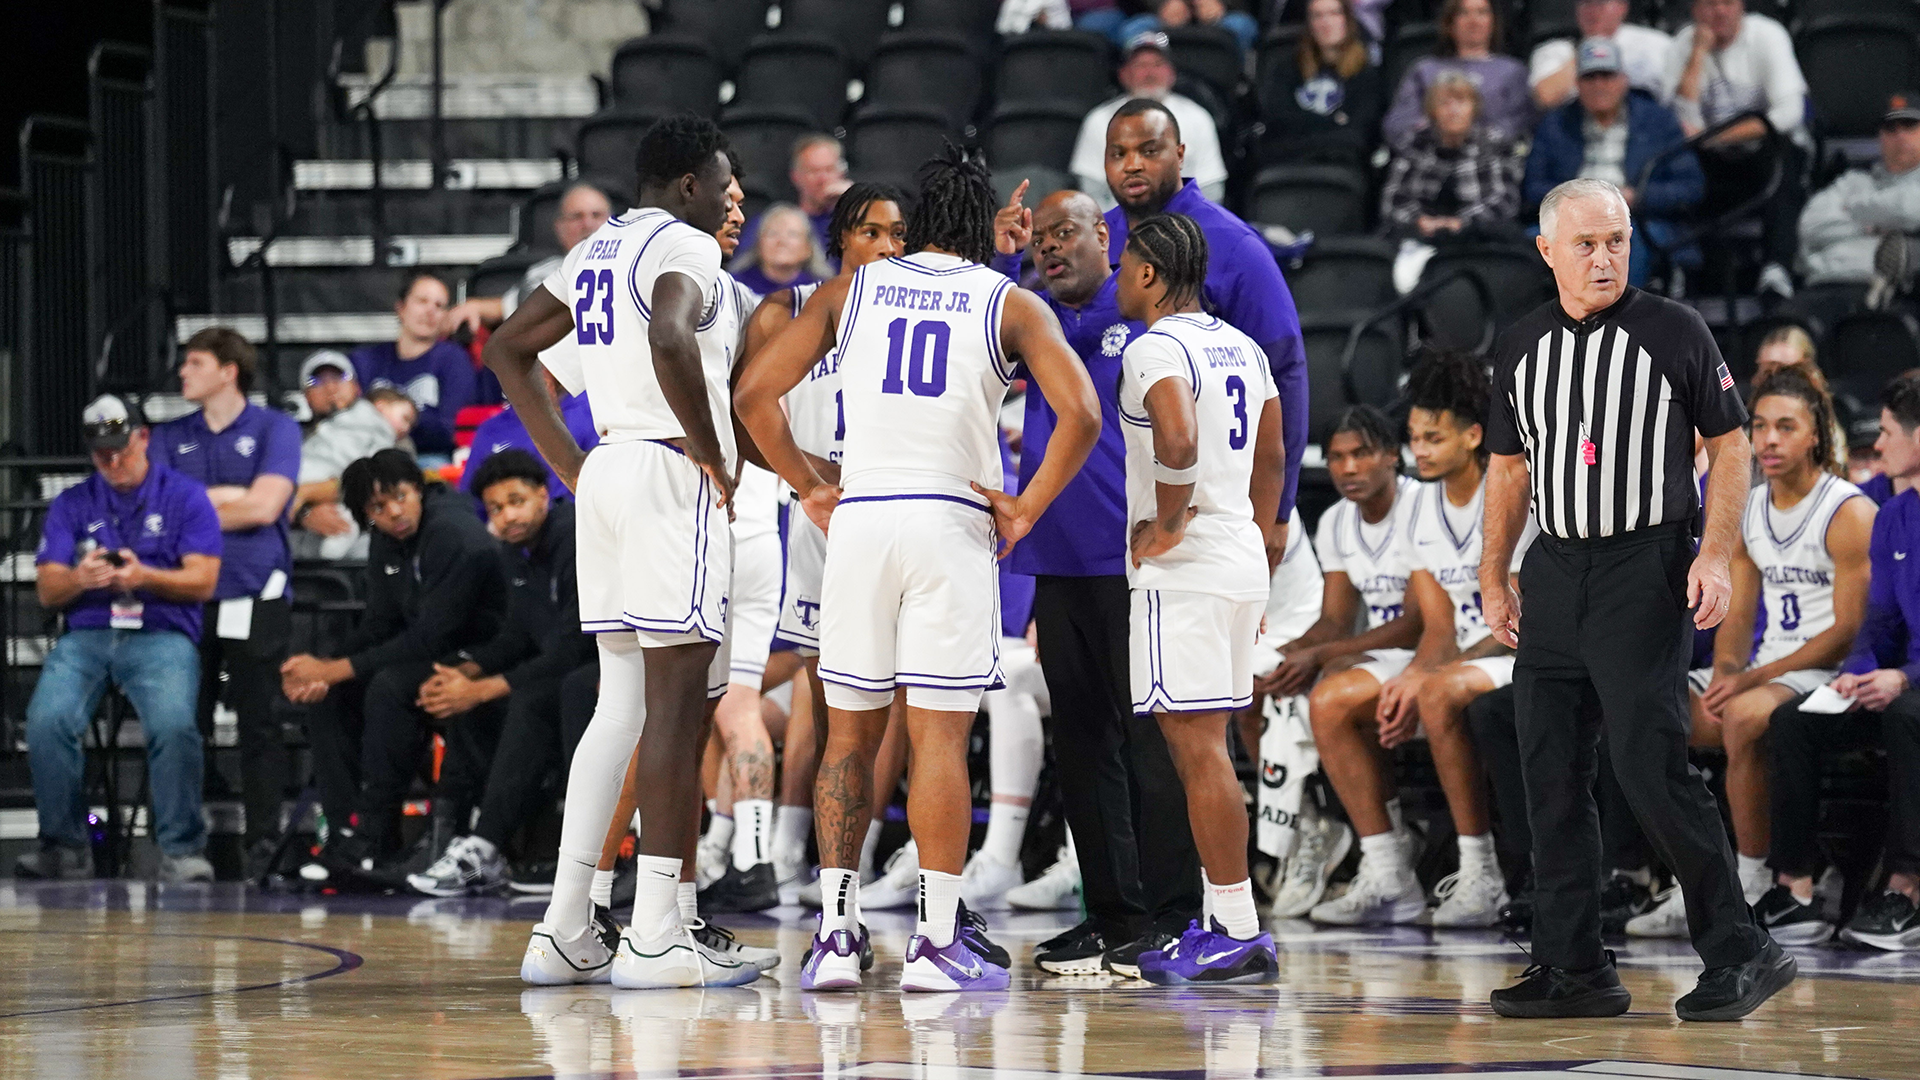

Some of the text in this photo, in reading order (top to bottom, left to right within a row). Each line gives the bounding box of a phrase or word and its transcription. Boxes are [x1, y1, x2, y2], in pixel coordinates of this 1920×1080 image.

[575, 269, 615, 346] 23
[873, 285, 972, 314] PORTER JR.
[882, 317, 951, 398] 10
[1202, 346, 1247, 369] DORMU
[1225, 375, 1248, 451] 3
[1781, 593, 1801, 631] 0
